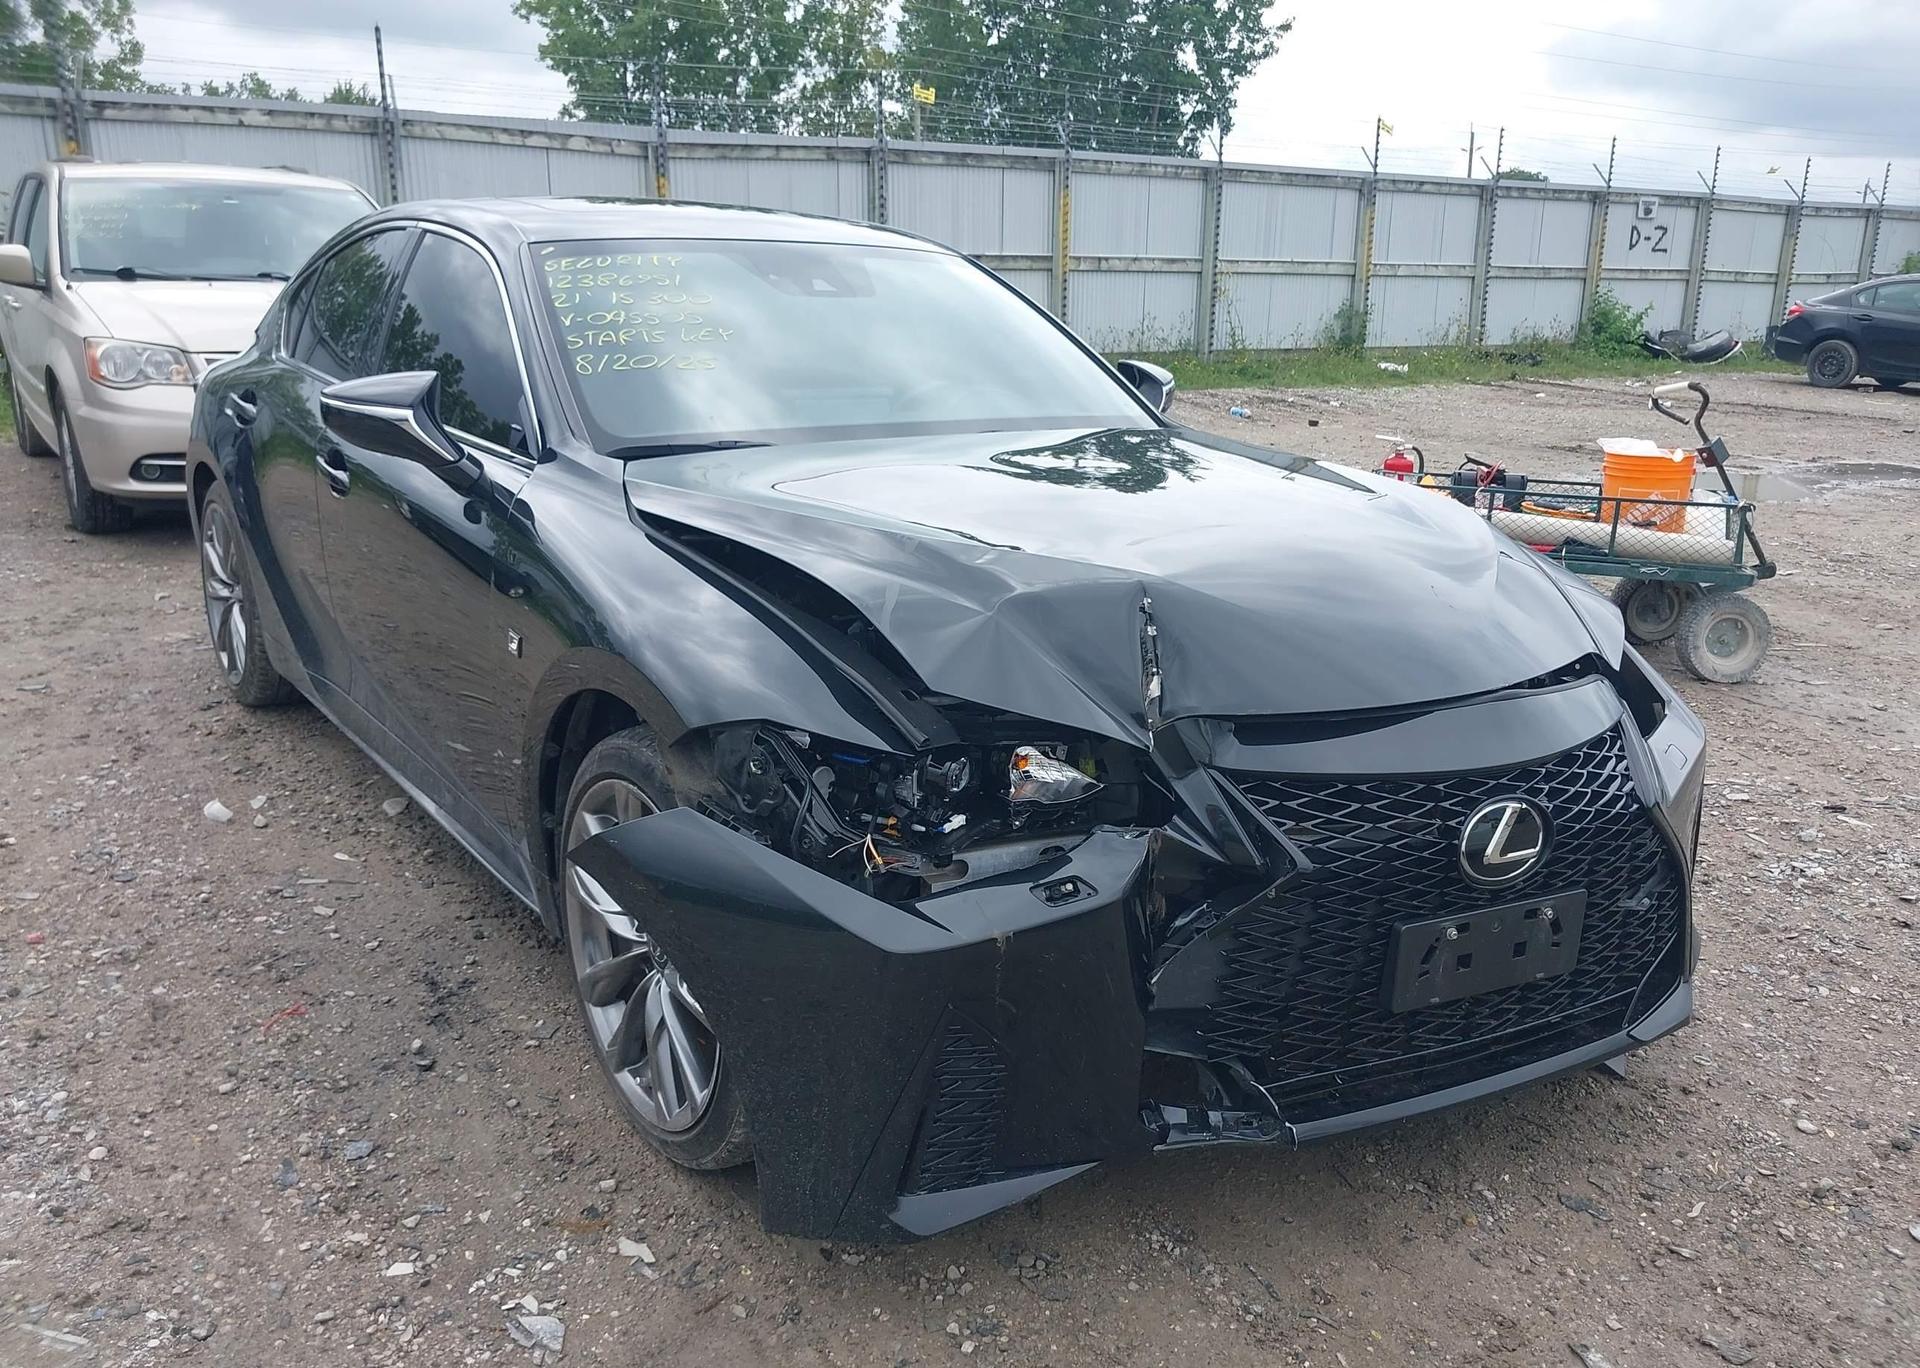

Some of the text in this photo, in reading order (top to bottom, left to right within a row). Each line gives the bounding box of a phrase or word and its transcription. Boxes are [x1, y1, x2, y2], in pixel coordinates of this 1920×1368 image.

[544, 255, 682, 272] SECURITY
[648, 293, 712, 305] 300
[567, 328, 734, 350] STARTS KEY
[576, 353, 717, 375] 8/20/25
